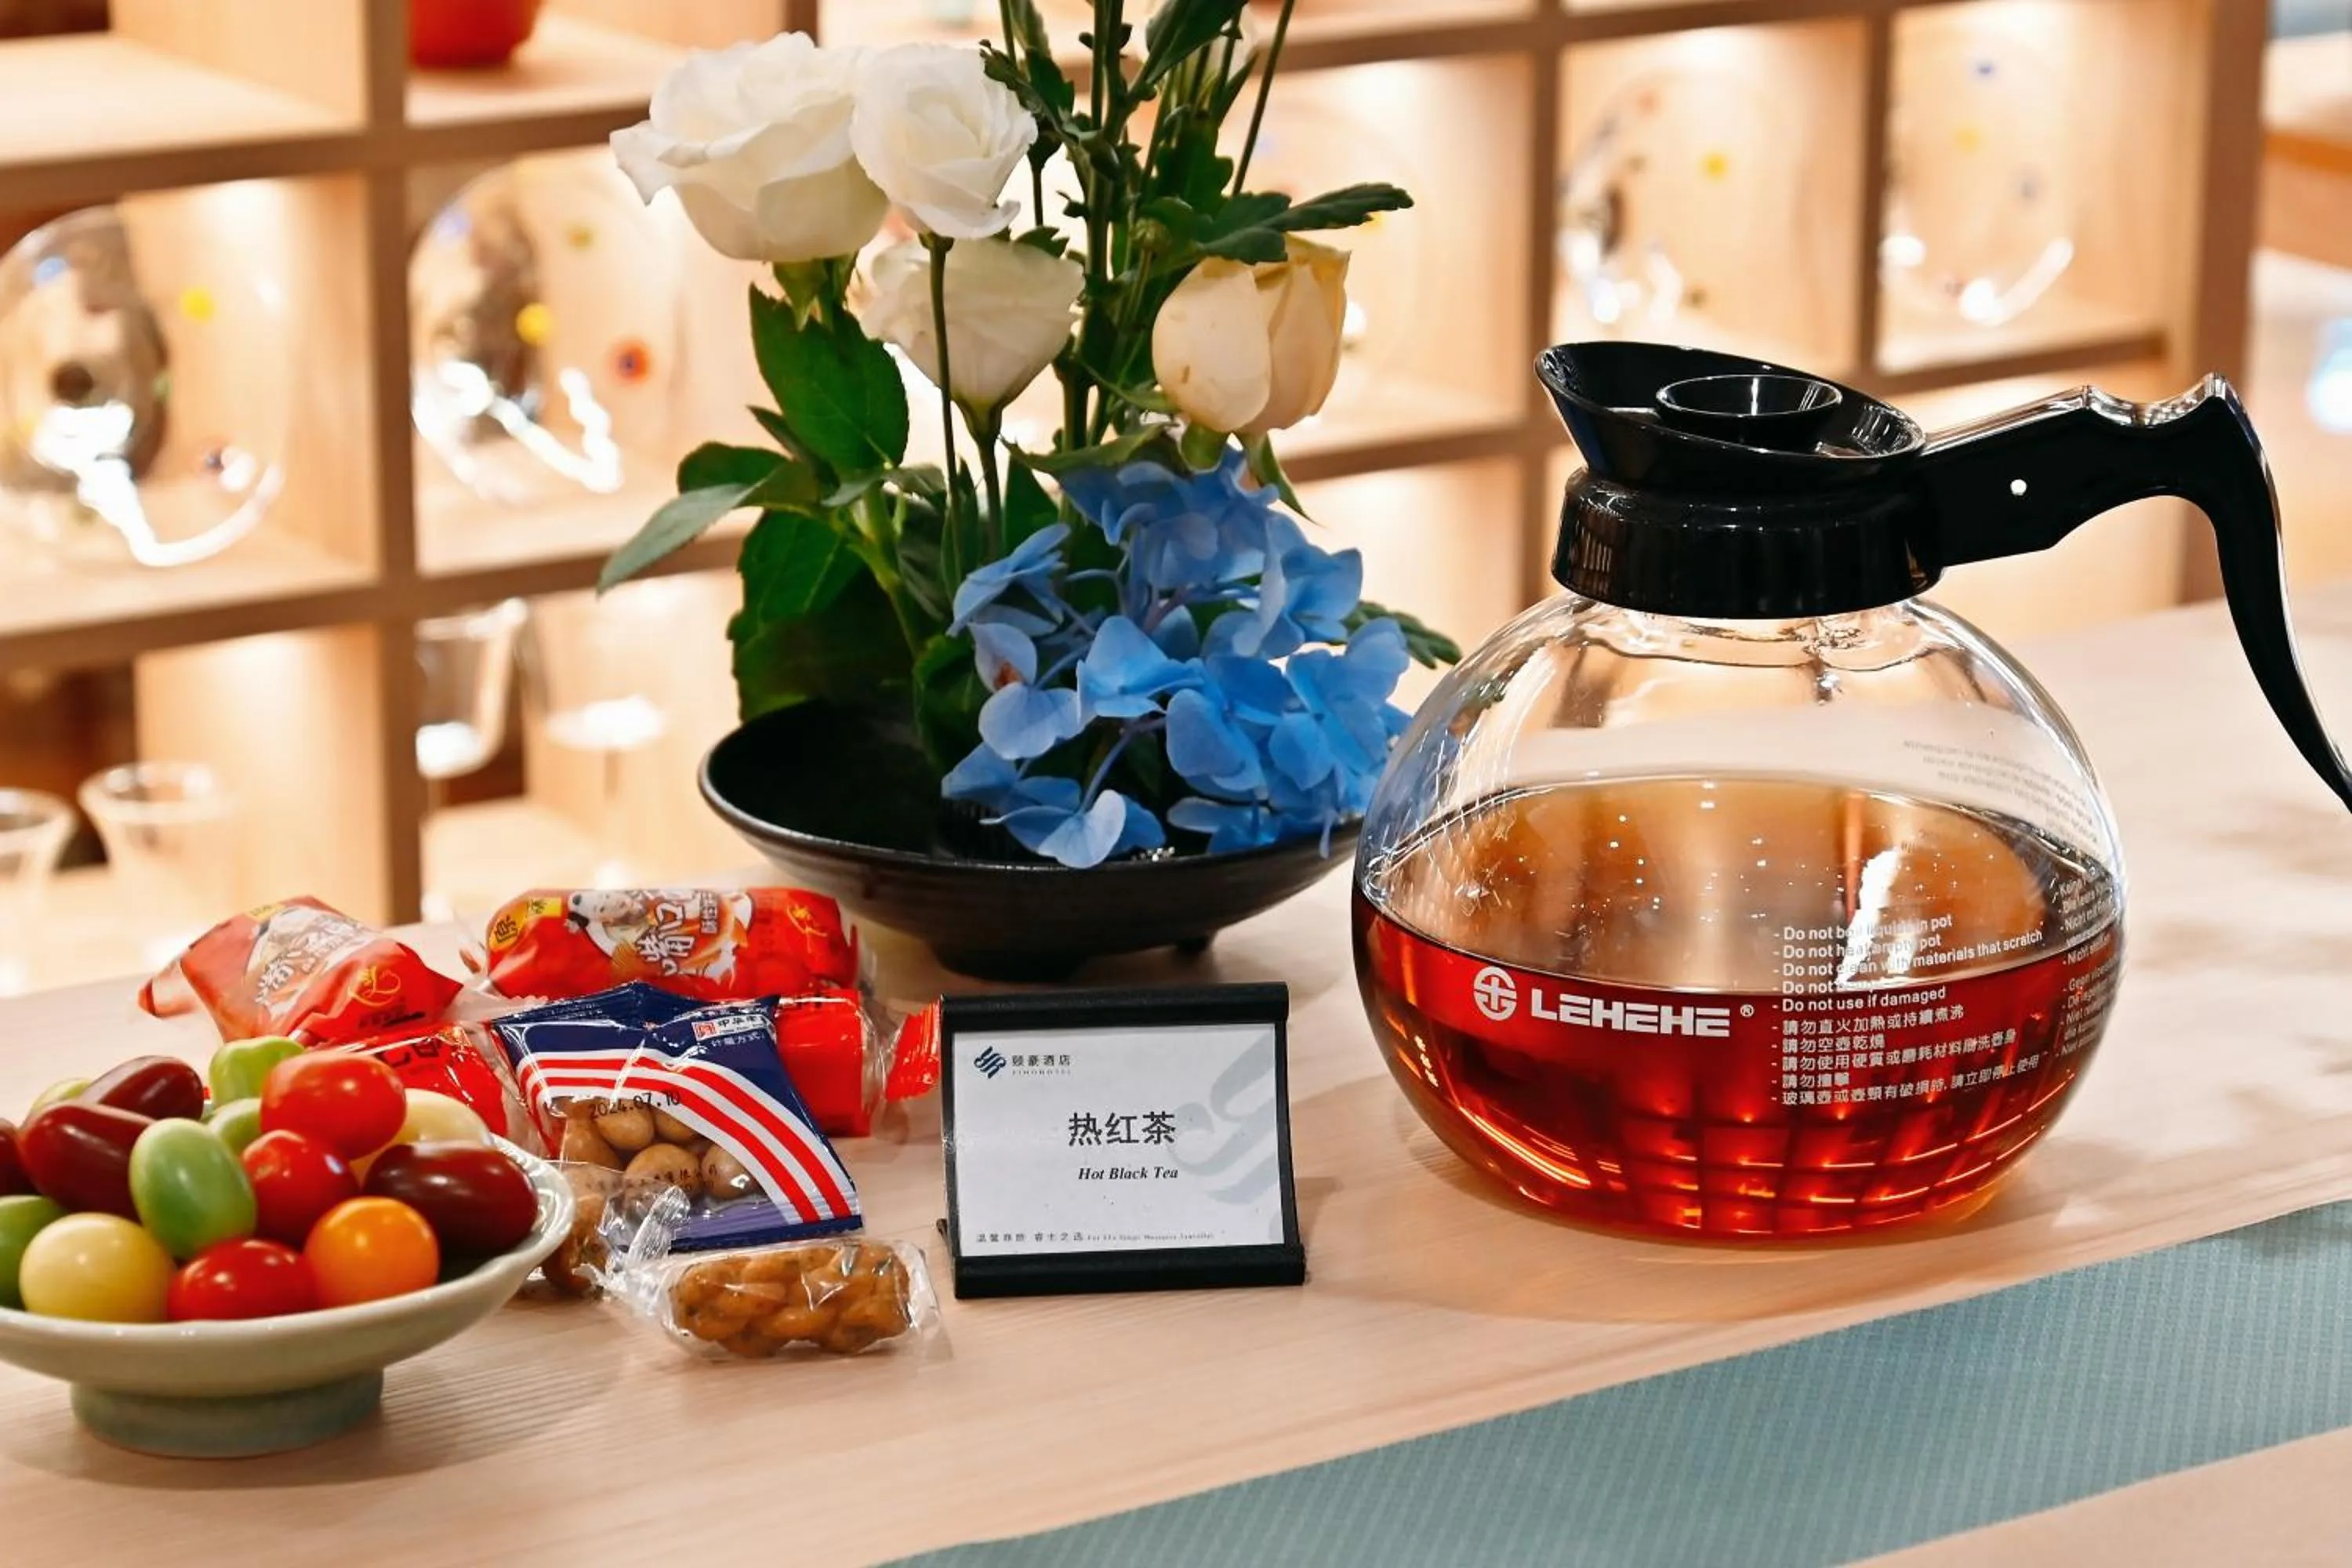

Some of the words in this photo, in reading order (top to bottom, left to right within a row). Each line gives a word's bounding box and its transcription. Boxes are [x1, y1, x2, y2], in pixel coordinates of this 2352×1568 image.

[1784, 926, 1805, 941] Do
[1809, 926, 1833, 940] not
[1931, 914, 1953, 932] pot
[1783, 945, 1805, 959] Do
[1809, 944, 1833, 958] not
[1920, 933, 1941, 950] pot
[1783, 963, 1805, 977] Do
[1809, 963, 1833, 976] not
[1913, 947, 1975, 967] materials
[1977, 942, 2001, 957] that
[2003, 928, 2043, 950] scratch
[1782, 981, 1805, 995] Do
[1808, 981, 1833, 994] not
[1782, 998, 1804, 1012] Do
[1808, 998, 1832, 1011] not
[1837, 996, 1864, 1010] use
[1867, 993, 1878, 1007] if
[1880, 985, 1946, 1007] damaged
[1531, 989, 1730, 1036] LEHEHE
[1069, 1111, 1176, 1146] 热红茶
[1078, 1167, 1105, 1180] Hot
[1109, 1167, 1148, 1180] Black
[1154, 1166, 1178, 1179] Tea
